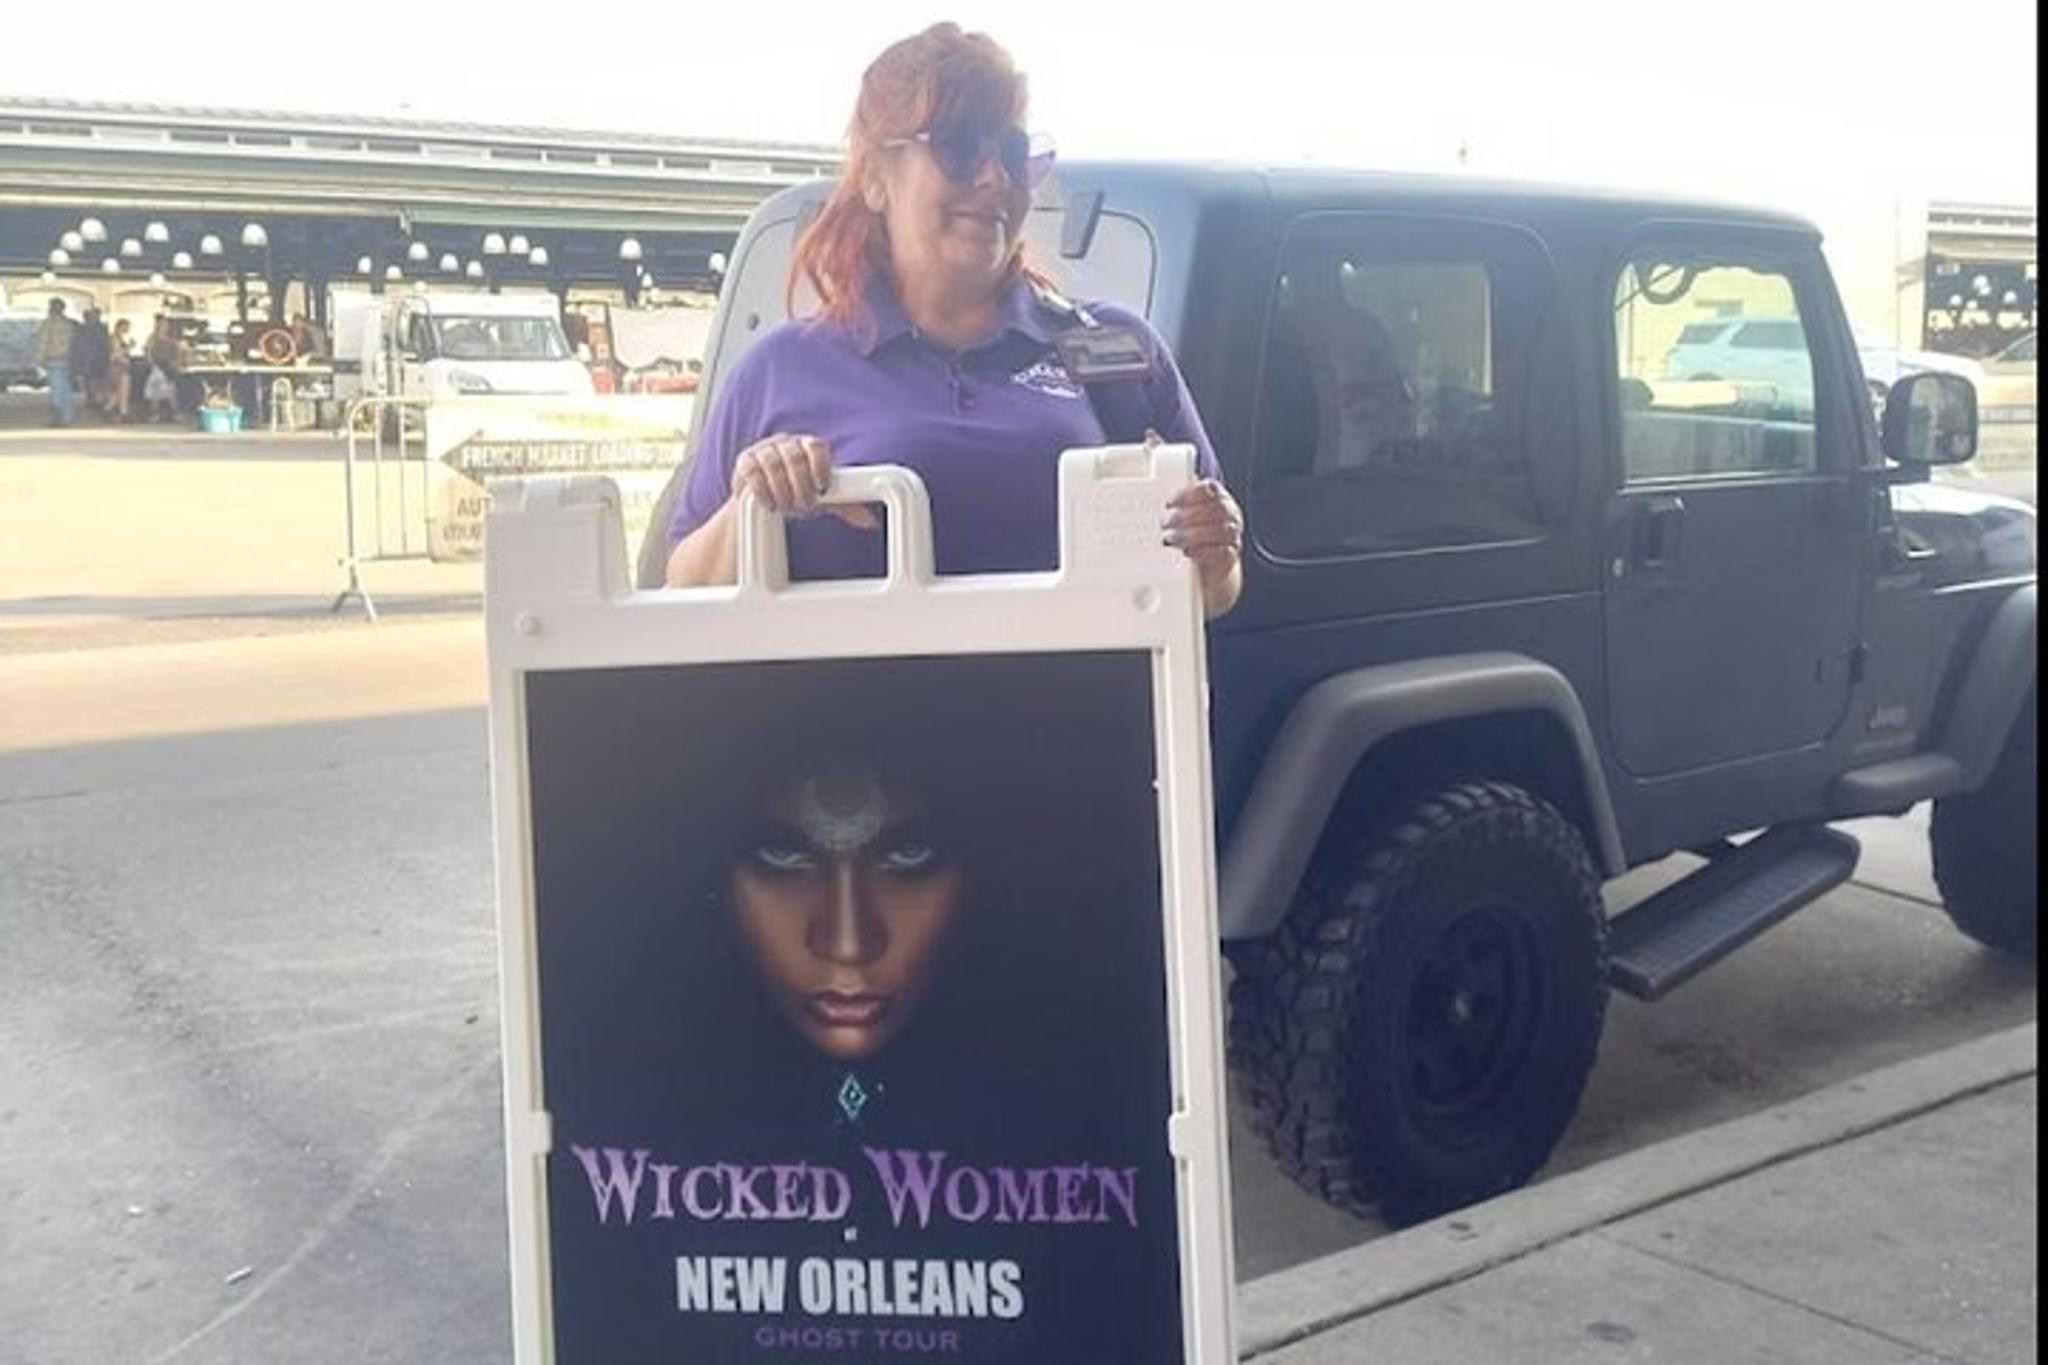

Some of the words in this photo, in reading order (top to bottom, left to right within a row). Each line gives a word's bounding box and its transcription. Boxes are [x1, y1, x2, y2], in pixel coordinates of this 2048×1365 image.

[462, 444, 523, 467] FRENCH
[528, 444, 585, 466] MARKET
[676, 1256, 787, 1312] NEW
[799, 1257, 1024, 1318] ORLEANS
[754, 1325, 861, 1350] GHOST
[874, 1327, 959, 1352] TOUR
